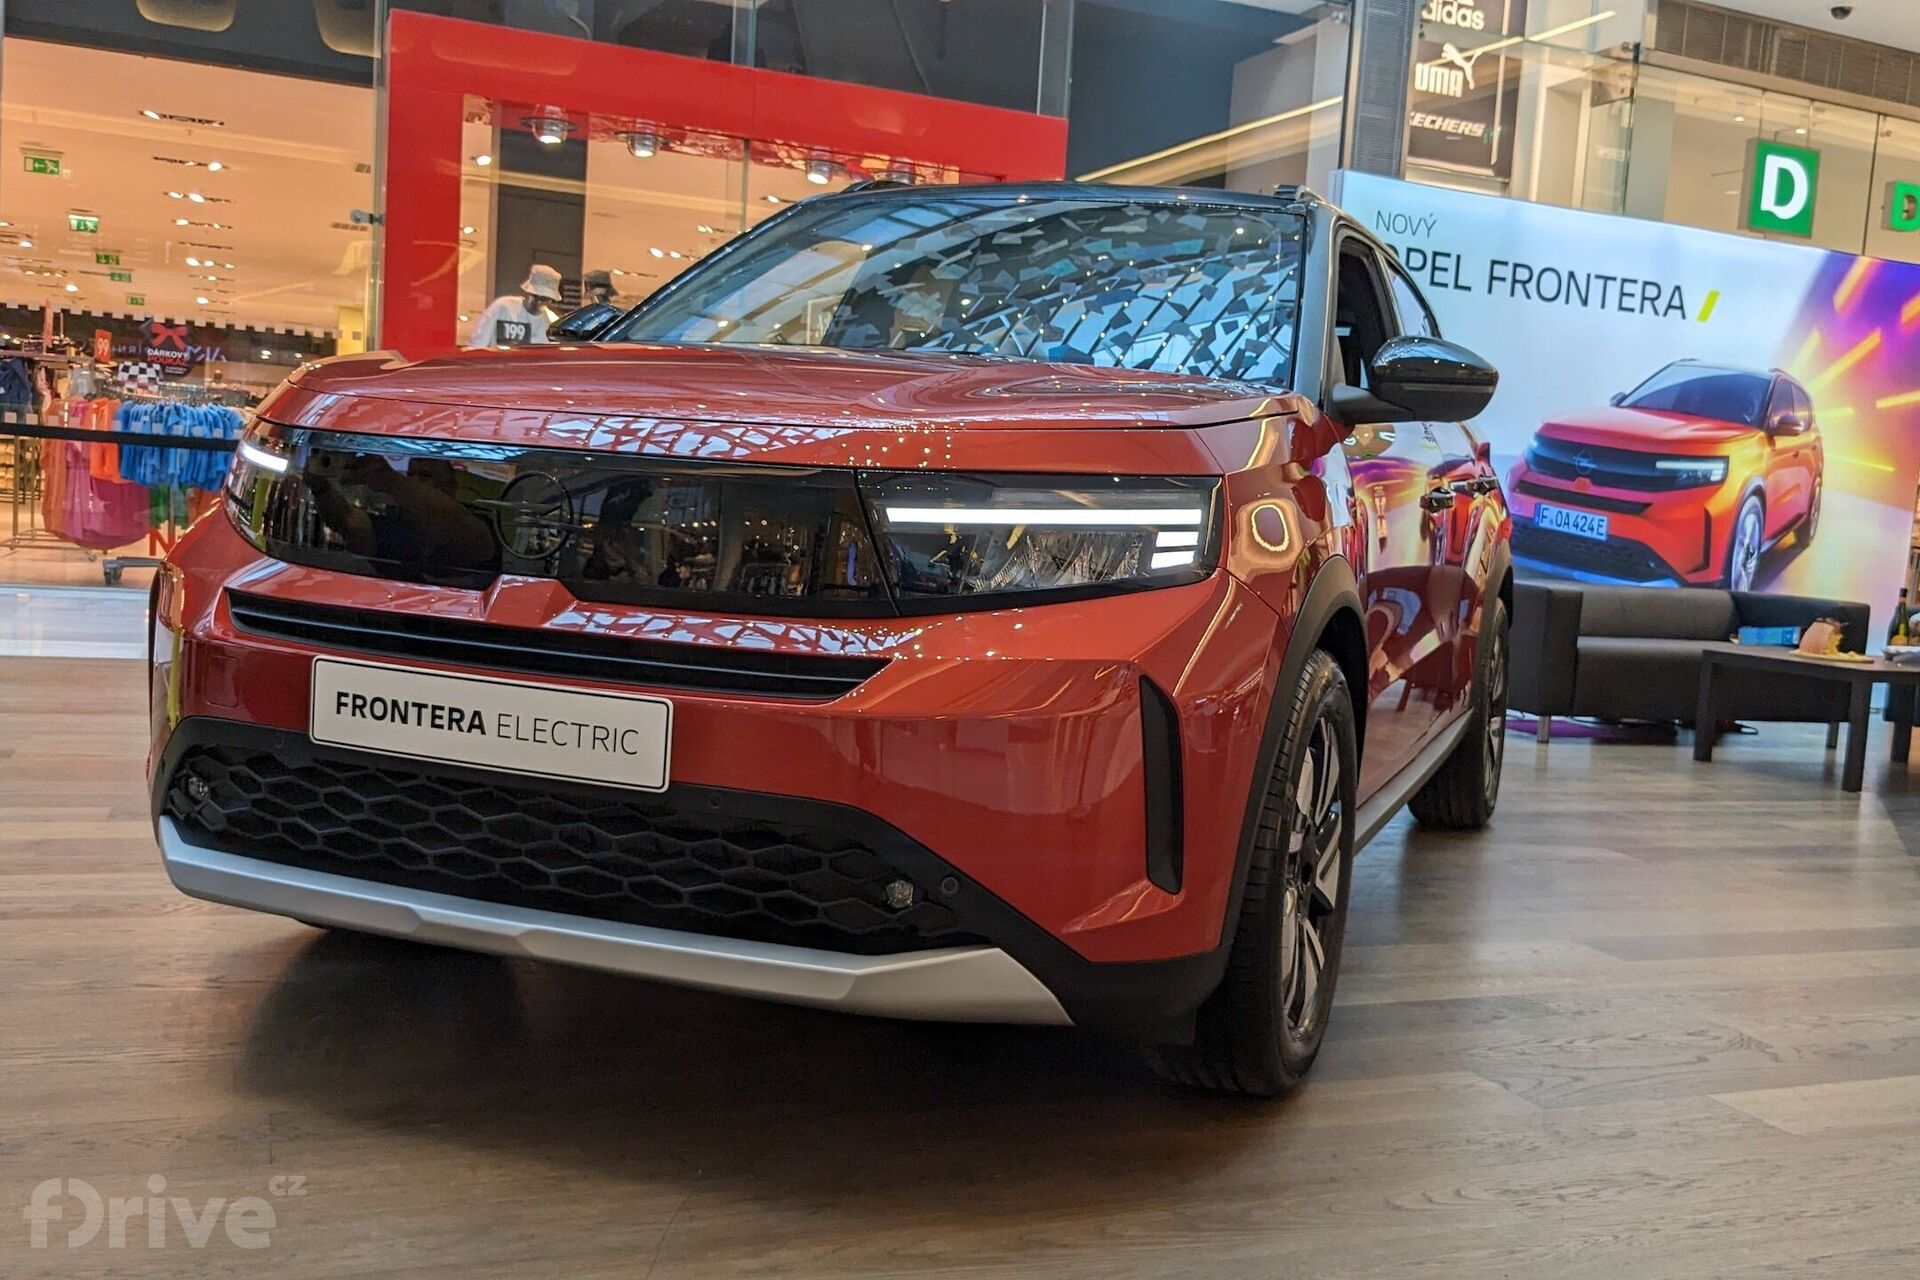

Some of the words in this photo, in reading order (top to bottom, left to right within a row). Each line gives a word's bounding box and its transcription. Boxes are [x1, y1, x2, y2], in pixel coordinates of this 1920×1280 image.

[1422, 0, 1485, 30] didas
[1414, 63, 1464, 98] UMA
[1409, 111, 1487, 138] ECHERS
[1760, 154, 1809, 220] D
[1376, 209, 1437, 238] NOVÝ
[1386, 243, 1472, 292] PEL
[1487, 259, 1687, 320] FRONTERA
[503, 322, 526, 341] 199
[335, 691, 487, 735] FRONTERA
[497, 713, 639, 755] ELECTRIC
